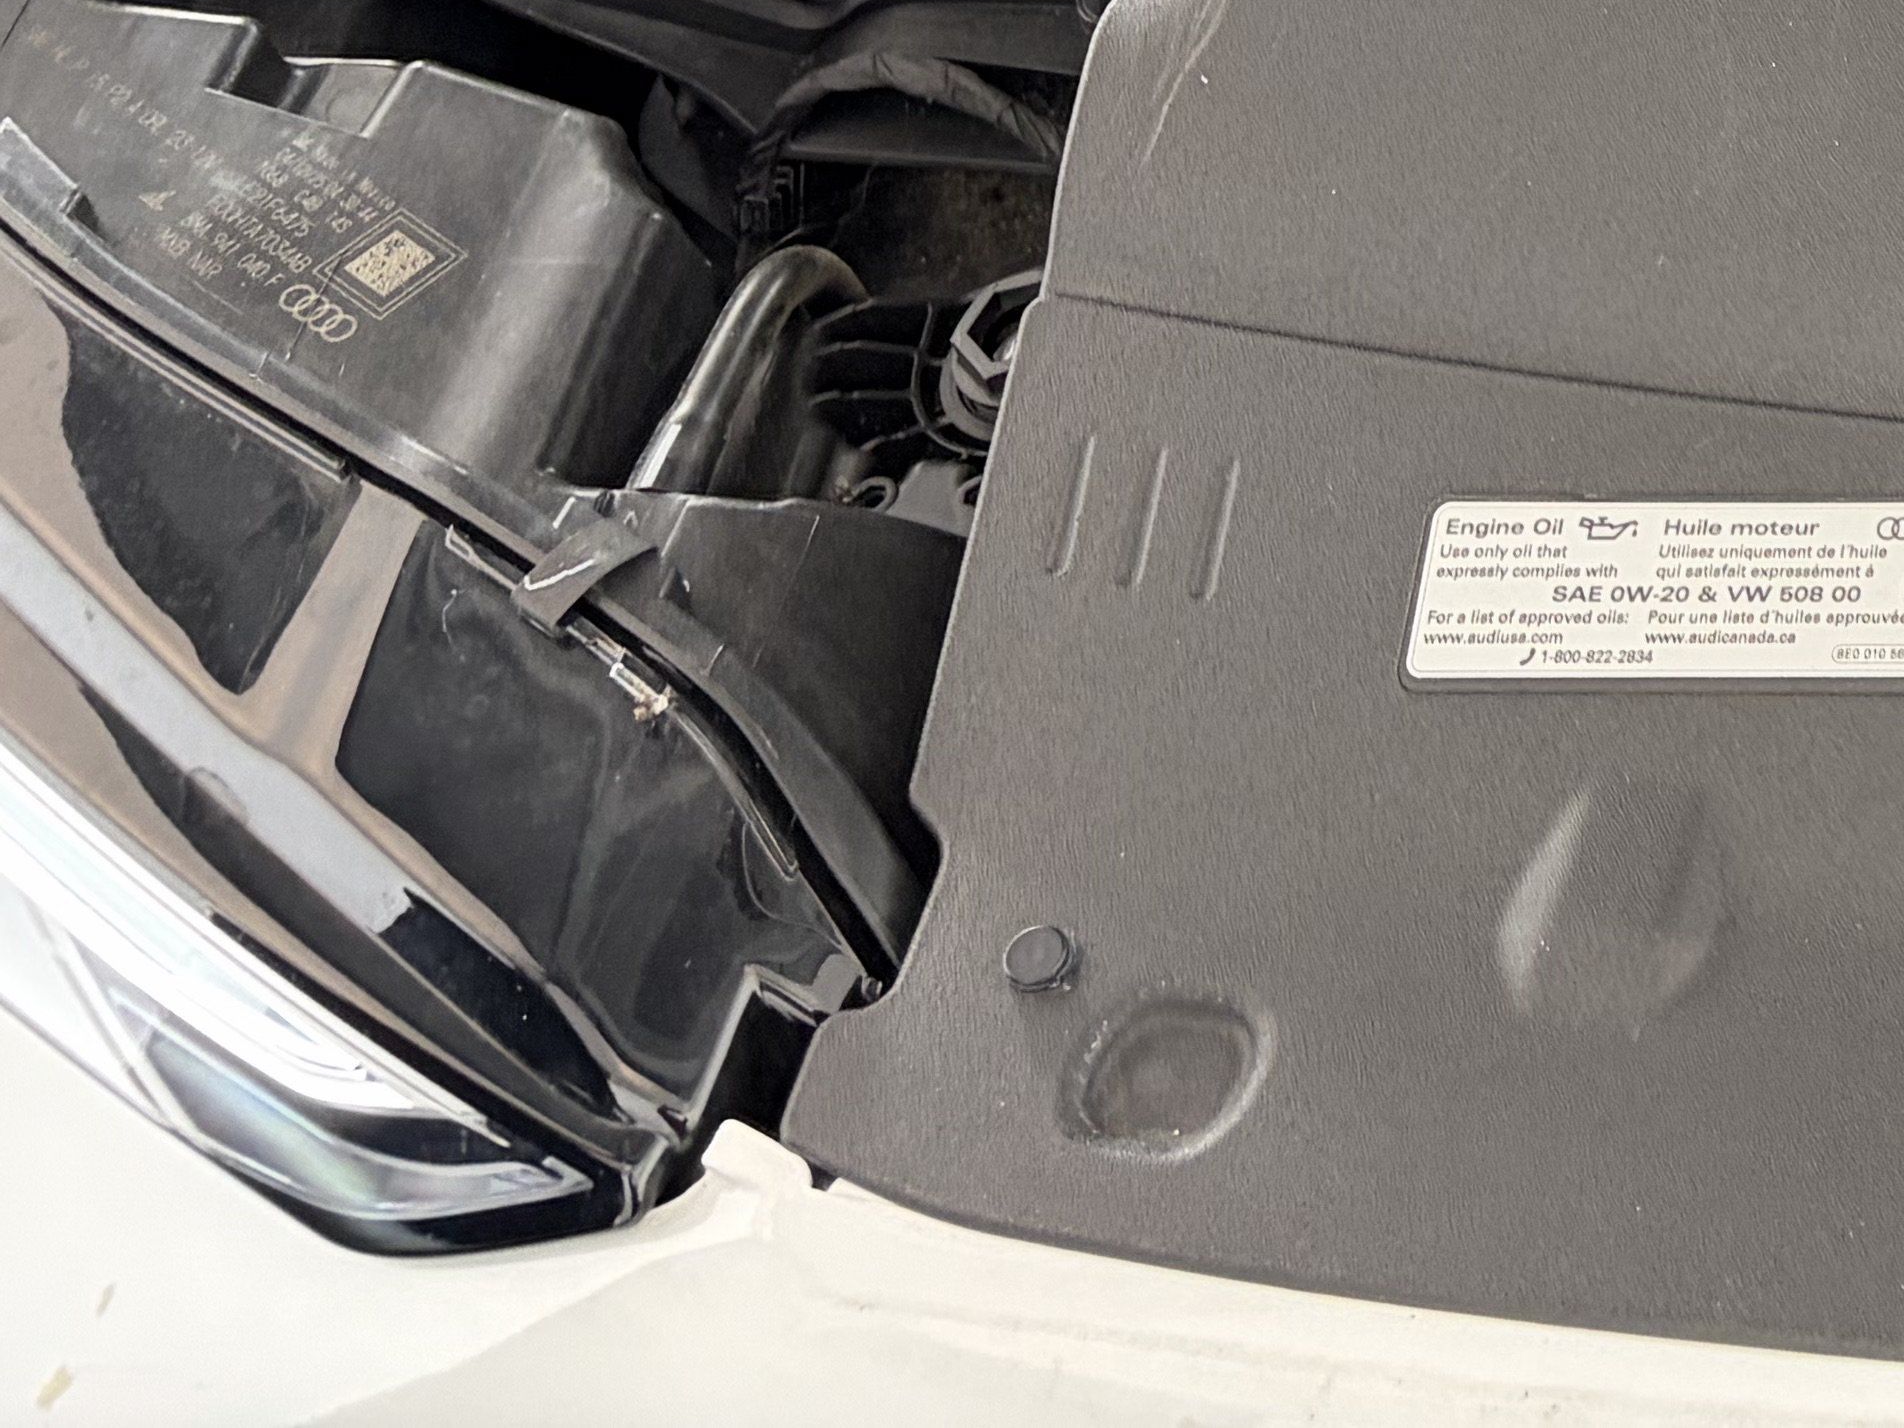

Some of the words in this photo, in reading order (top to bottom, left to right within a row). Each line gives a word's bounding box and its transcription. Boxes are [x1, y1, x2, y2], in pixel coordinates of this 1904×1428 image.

[1446, 519, 1524, 538] Engine
[1534, 519, 1564, 535] Oil
[1664, 518, 1722, 536] Huile
[1730, 520, 1820, 536] moteur
[1440, 545, 1469, 558] Use
[1475, 545, 1507, 561] only
[1513, 544, 1533, 558] oil
[1538, 545, 1567, 558] that
[1659, 545, 1714, 558] Utilisez
[1720, 545, 1812, 561] uniquement
[1816, 545, 1836, 558] de
[1840, 544, 1888, 558] l'huile
[1437, 564, 1507, 579] expressly
[1513, 565, 1580, 580] complies
[1586, 565, 1617, 578] with
[1656, 565, 1680, 580] qui
[1686, 564, 1746, 578] satisfait
[1751, 565, 1860, 581] expressément
[1552, 586, 1601, 602] SAE
[1611, 586, 1689, 603] 0W-20
[1698, 586, 1717, 602] &
[1728, 586, 1772, 602] VW
[1780, 586, 1823, 602] 508
[1832, 586, 1861, 602] 00
[1428, 611, 1453, 625] For
[1457, 614, 1465, 624] a
[1471, 611, 1494, 624] list
[1500, 610, 1515, 624] of
[1519, 611, 1592, 626] approved
[1597, 611, 1629, 624] oils:
[1649, 610, 1684, 624] Pour
[1689, 613, 1718, 624] une
[1723, 610, 1754, 624] liste
[1760, 610, 1820, 624] d'huiles
[1424, 630, 1562, 644] www.audiusa.com
[1645, 632, 1796, 644] www.audicanada.ca
[1542, 650, 1653, 664] 1-800-822-2834
[1864, 647, 1885, 659] 010
